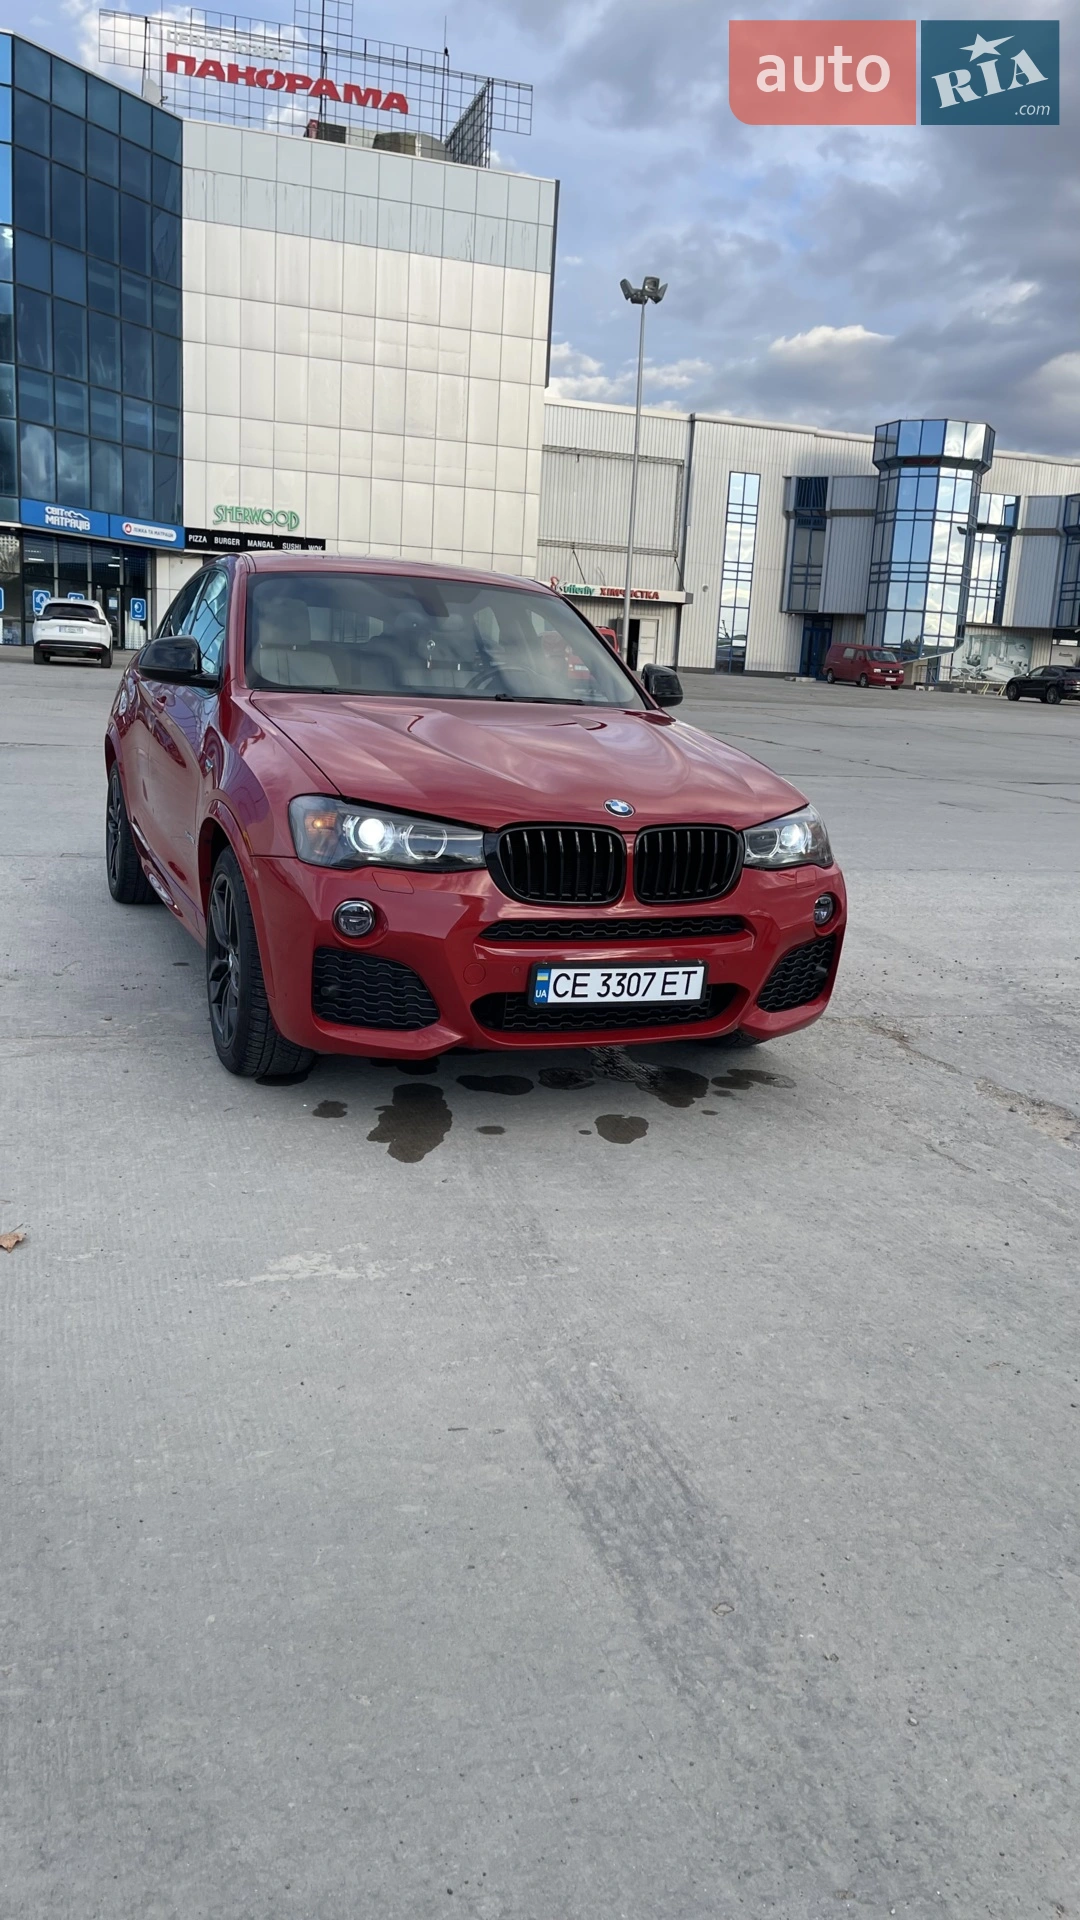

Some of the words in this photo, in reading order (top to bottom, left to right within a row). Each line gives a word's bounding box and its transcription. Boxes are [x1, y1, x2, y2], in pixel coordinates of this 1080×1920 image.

[166, 29, 222, 50] ЦЕНТР
[227, 40, 291, 61] РОЗВАГ
[166, 52, 409, 115] ПАНОРАМА
[213, 504, 300, 532] SHERWOOD
[188, 534, 208, 543] PIZZA
[214, 537, 241, 546] BURGER
[247, 540, 275, 549] MANGAL
[535, 989, 547, 998] UA
[552, 972, 590, 998] CE
[597, 971, 657, 998] 3307
[660, 970, 698, 996] ET
